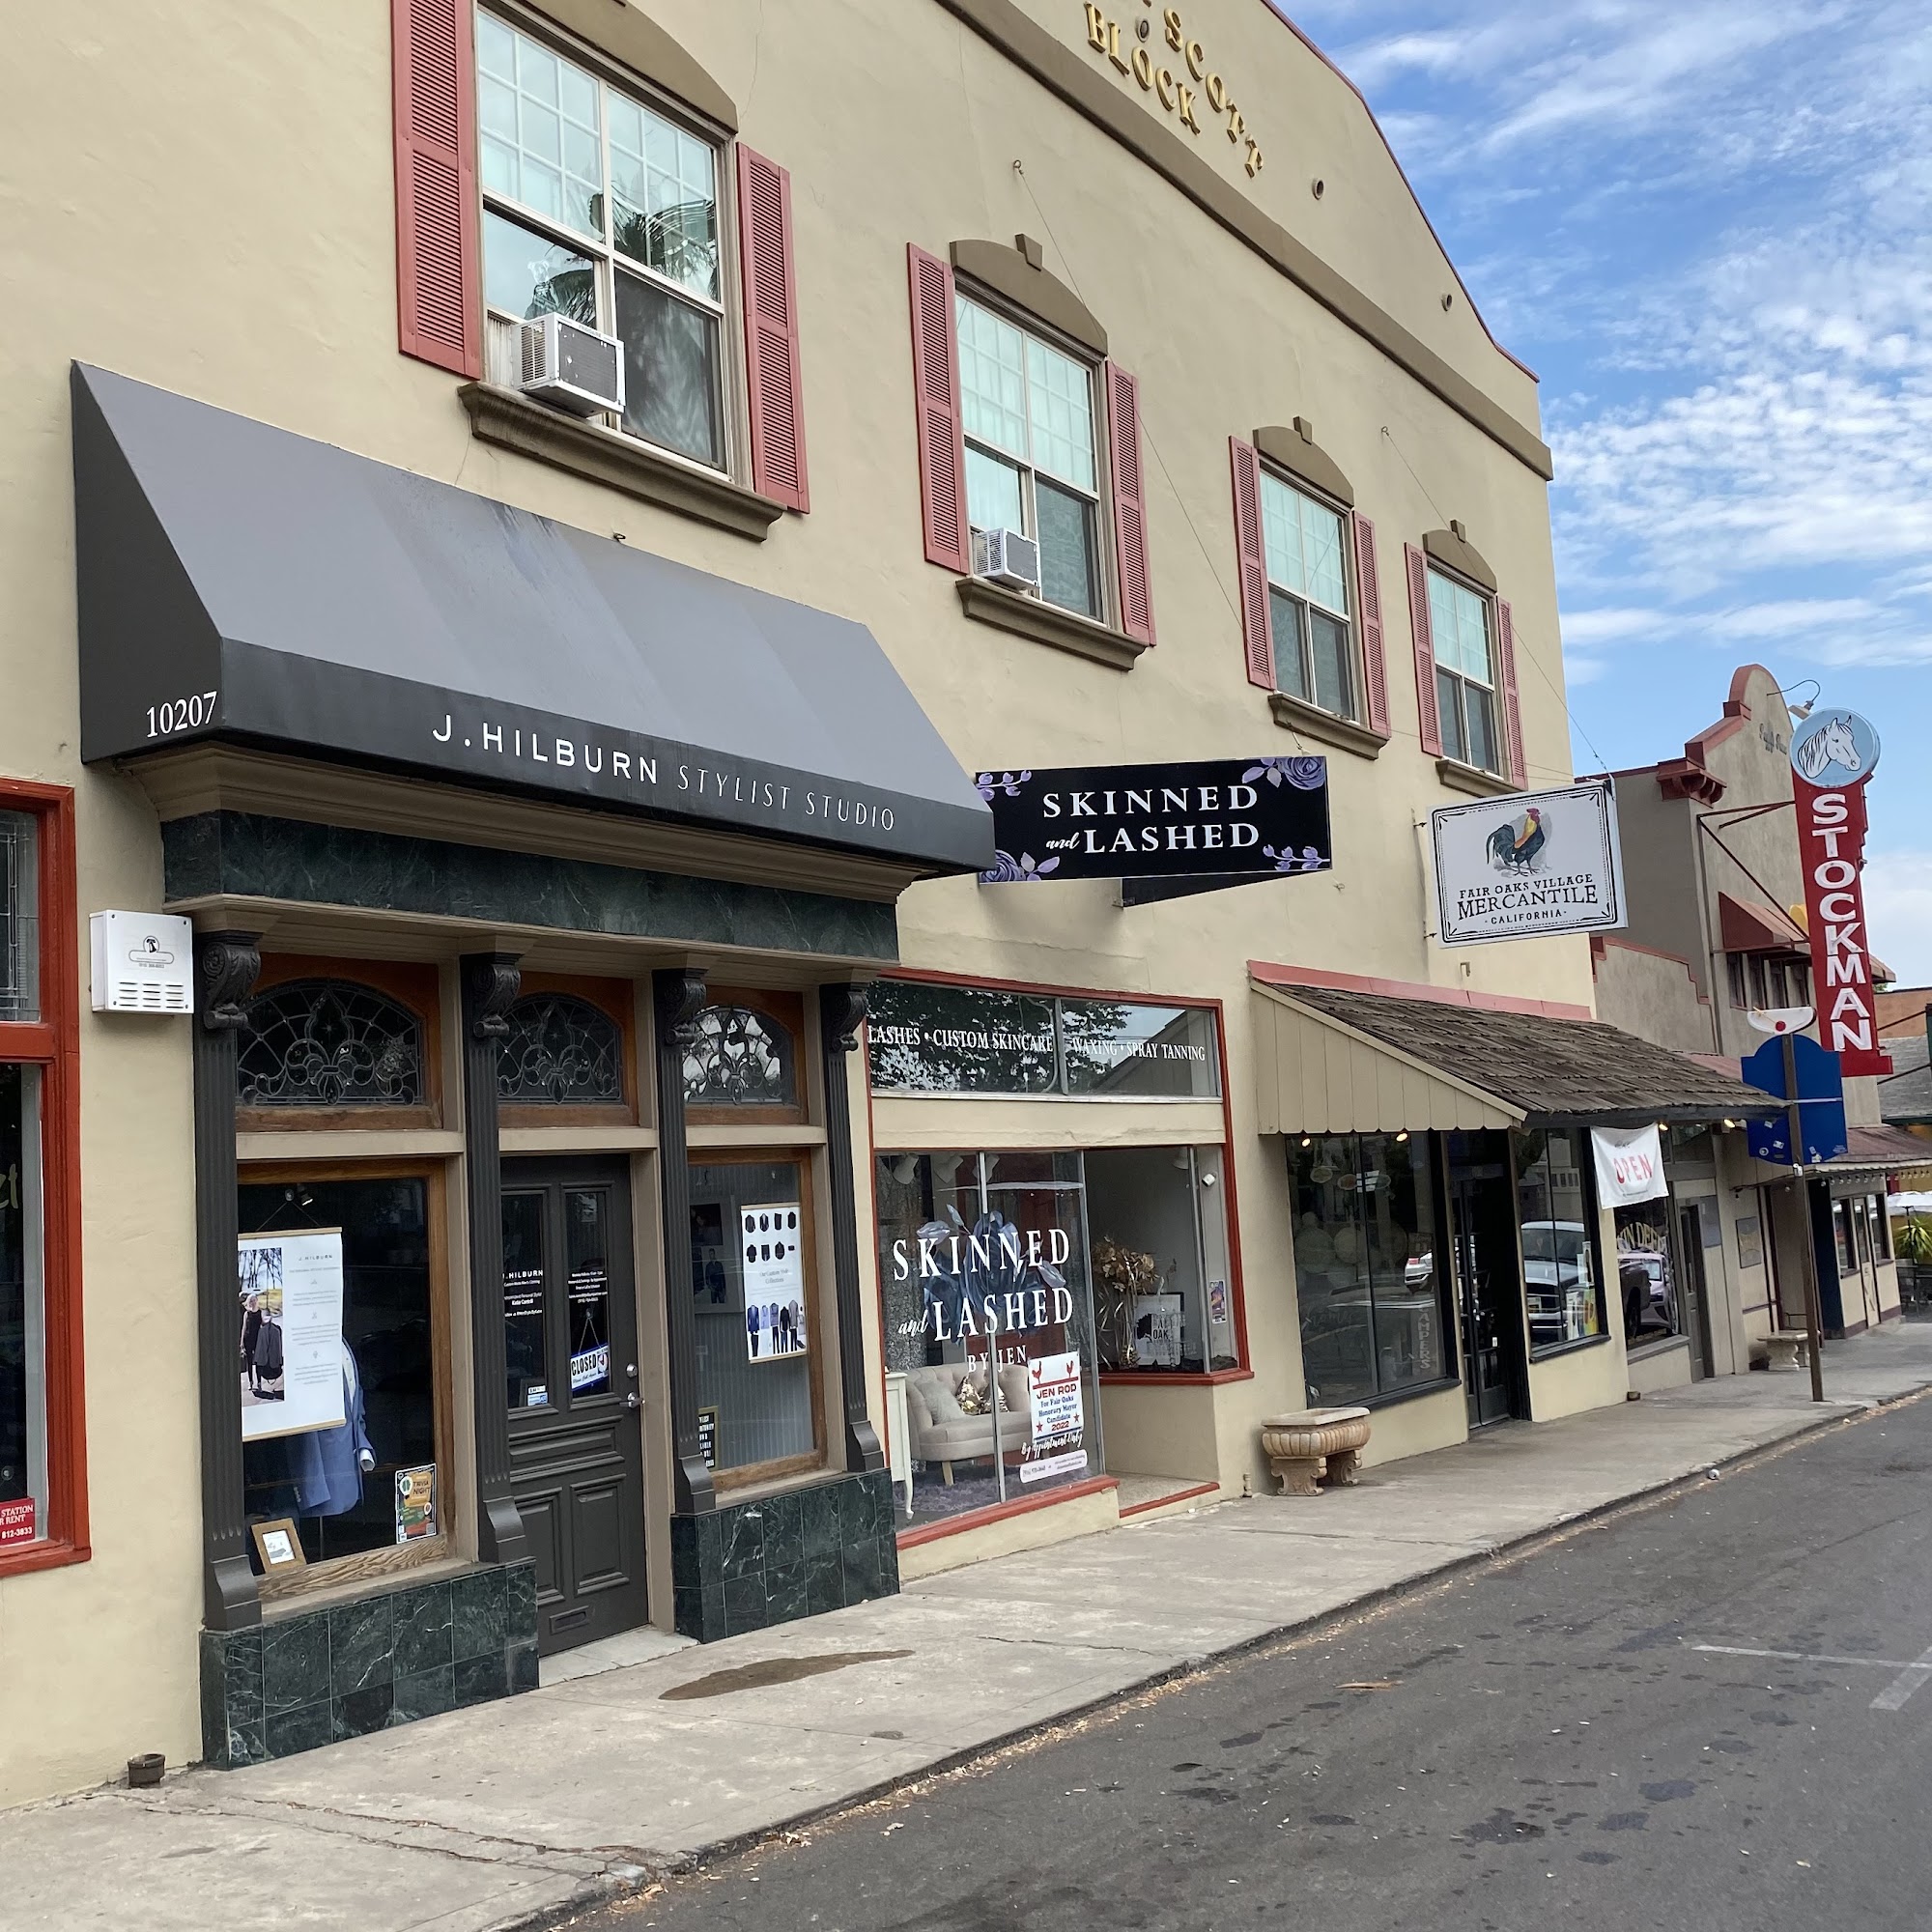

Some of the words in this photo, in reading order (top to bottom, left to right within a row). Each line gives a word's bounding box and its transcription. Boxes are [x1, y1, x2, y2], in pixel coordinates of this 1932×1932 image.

[1084, 1, 1201, 135] BLOCK
[1163, 8, 1264, 179] SCOTT
[146, 691, 217, 738] 10207
[677, 764, 790, 810] STYLIST
[806, 792, 895, 831] STUDIO
[1042, 784, 1258, 818] SKINNED
[1045, 832, 1080, 850] and
[1083, 822, 1260, 854] LASHED
[1460, 887, 1491, 899] FAIR
[1494, 882, 1529, 895] OAKS
[1534, 873, 1593, 890] VILLAGE
[1457, 885, 1599, 921] MERCANTILE
[1491, 909, 1562, 924] CALIFORNIA
[1810, 793, 1872, 1052] STOCKMAN
[867, 1024, 921, 1045] LASHES
[932, 1029, 990, 1050] CUSTOM
[992, 1033, 1054, 1053] SKINCARE
[1126, 1041, 1159, 1059] SPRAY
[1161, 1043, 1207, 1062] TANNING
[1613, 1153, 1653, 1184] OPEN
[893, 1228, 1069, 1282] SKINNED
[898, 1309, 929, 1338] and
[932, 1287, 1074, 1342] LASHED
[571, 1353, 597, 1377] CLOSED
[967, 1352, 990, 1373] BY
[998, 1345, 1028, 1373] JEN
[1037, 1388, 1055, 1399] JEN
[1057, 1383, 1077, 1395] ROD
[1051, 1421, 1068, 1431] 2022
[1, 1504, 33, 1517] STATION
[6, 1514, 25, 1524] RENT
